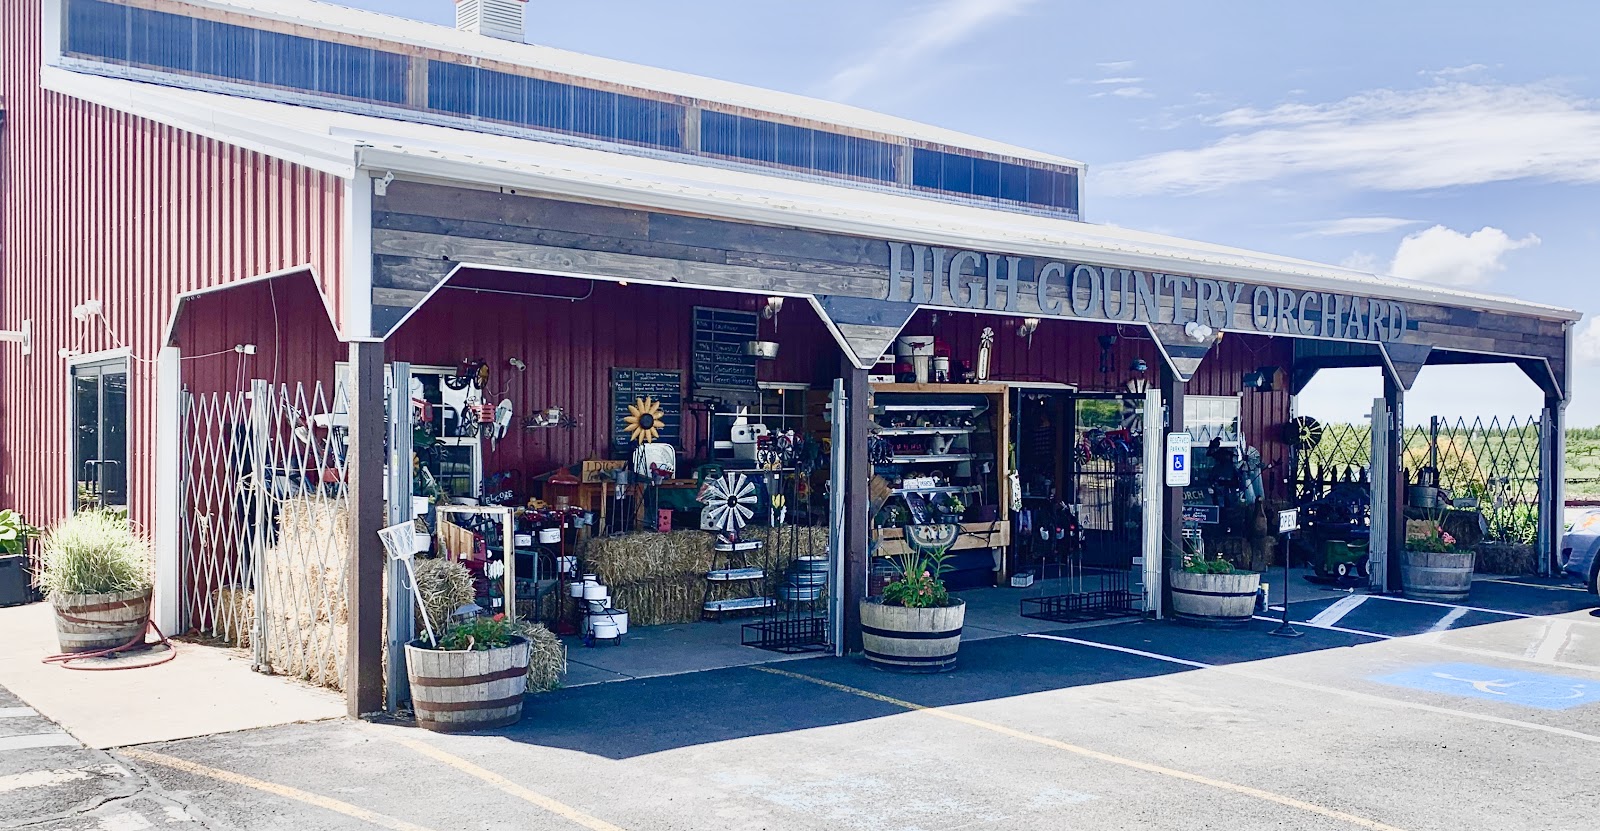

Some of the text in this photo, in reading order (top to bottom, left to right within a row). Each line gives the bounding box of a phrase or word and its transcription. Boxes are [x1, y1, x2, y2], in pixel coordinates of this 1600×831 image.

[887, 241, 1408, 343] HIGH COUNTRY ORCHARD
[1169, 445, 1188, 453] PARKING
[1280, 514, 1296, 528] OPEN
